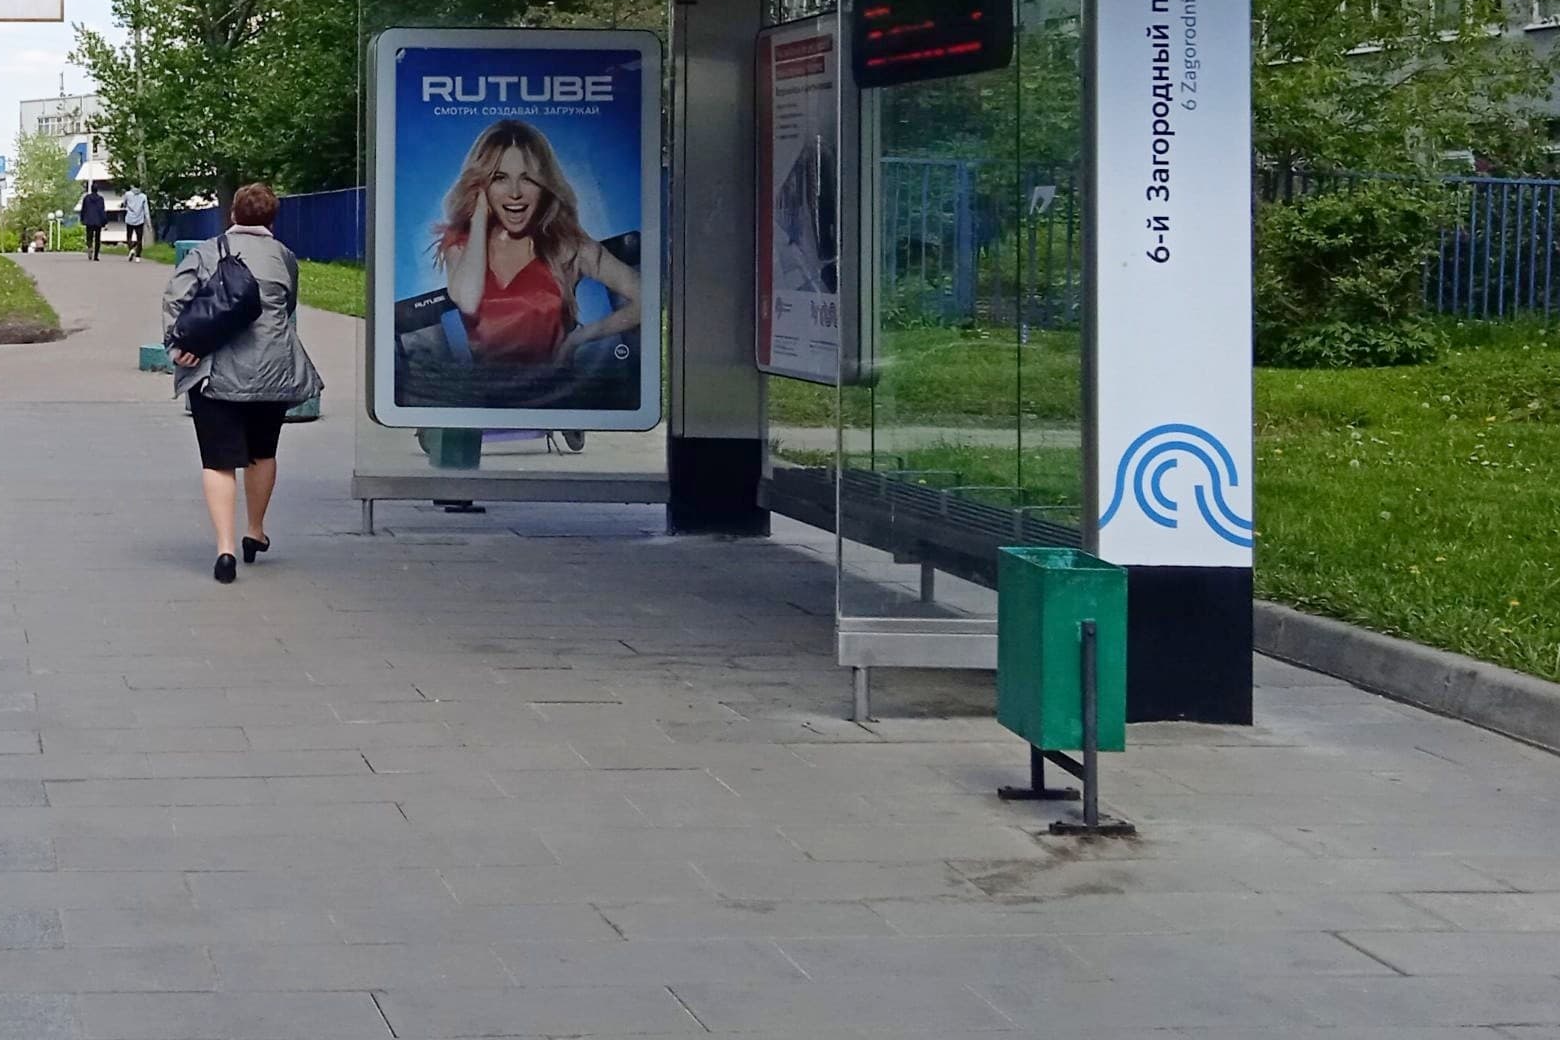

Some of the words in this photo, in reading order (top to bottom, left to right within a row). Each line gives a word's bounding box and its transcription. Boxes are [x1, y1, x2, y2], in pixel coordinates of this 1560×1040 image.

[422, 75, 614, 102] RUTUBE
[1181, 99, 1197, 112] 6
[1146, 25, 1175, 204] Загородный
[1147, 214, 1171, 264] 6-й
